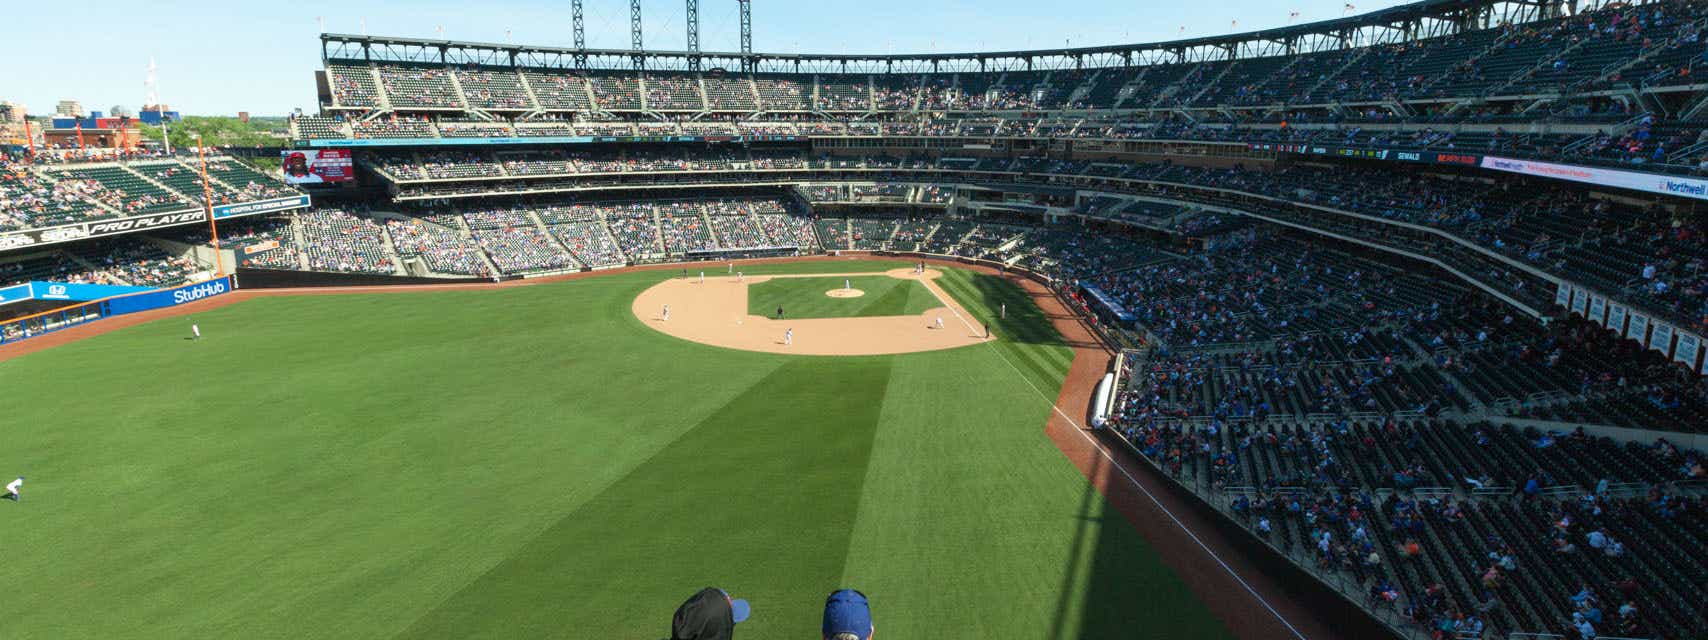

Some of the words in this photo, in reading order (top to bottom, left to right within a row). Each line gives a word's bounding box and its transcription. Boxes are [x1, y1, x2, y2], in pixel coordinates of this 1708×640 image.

[1398, 152, 1420, 161] SEWALD
[1666, 181, 1706, 195] Northwell
[90, 220, 134, 234] PRO
[134, 211, 203, 228] PLAYER
[174, 282, 224, 304] StubHub
